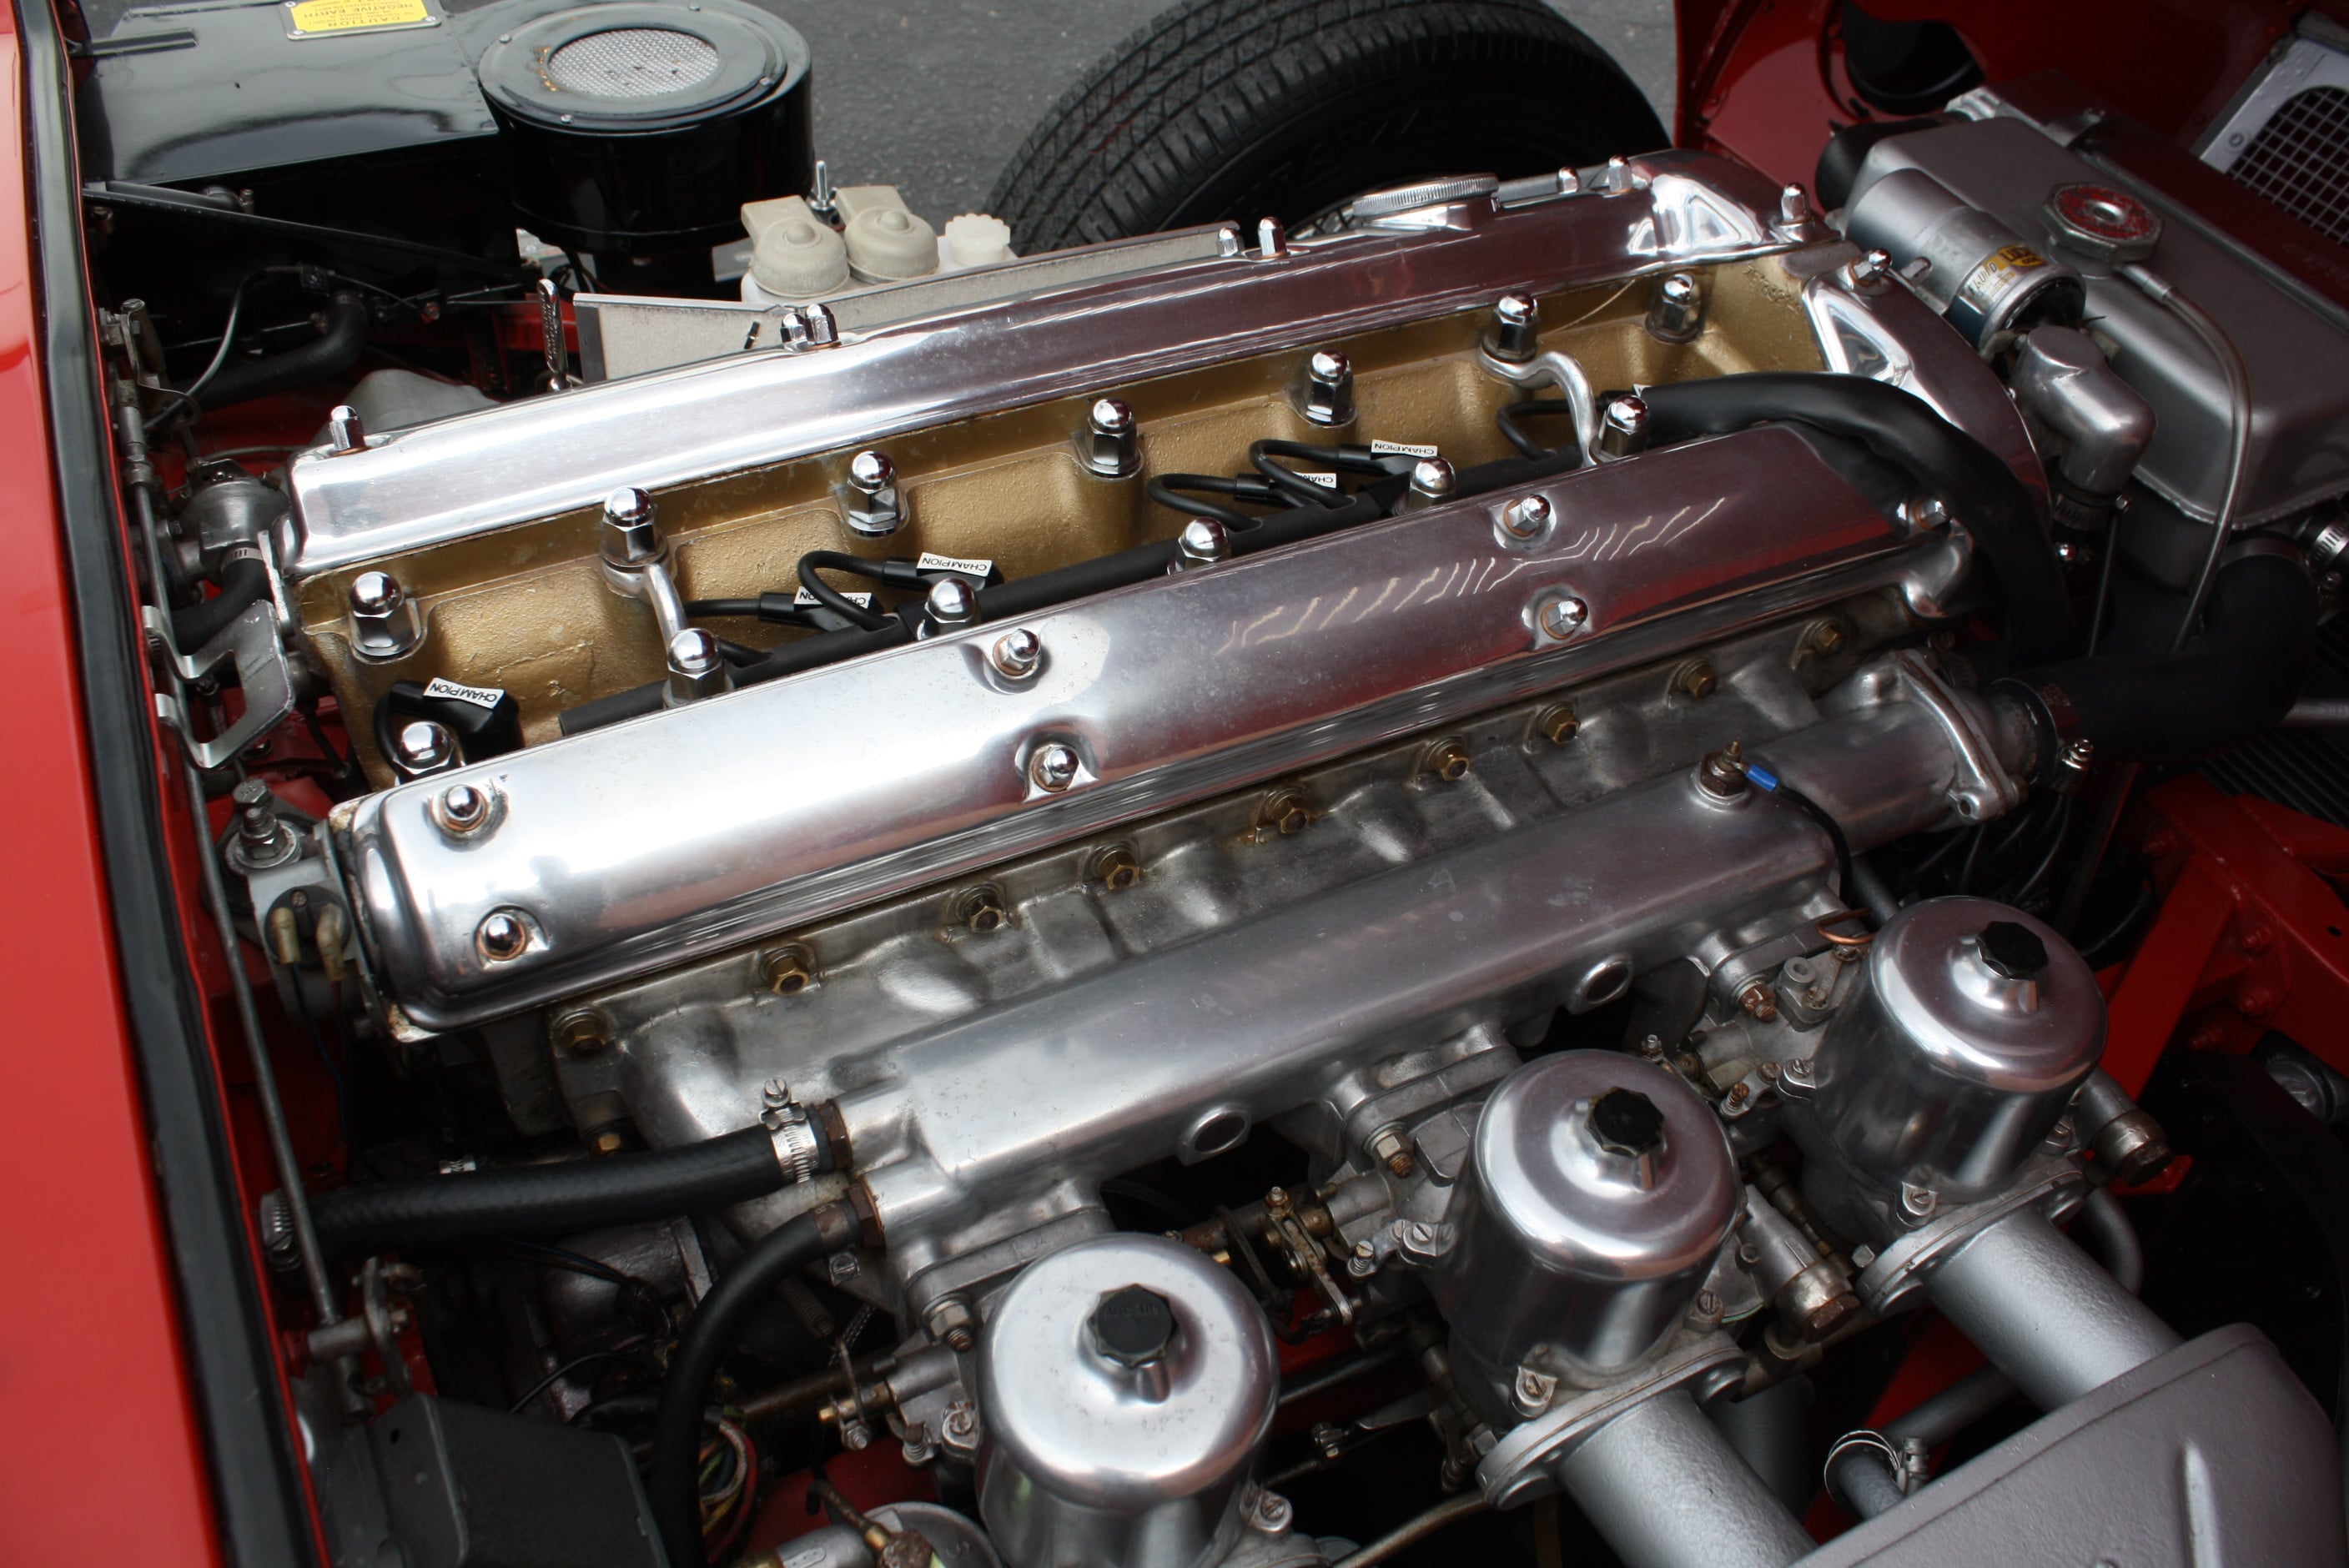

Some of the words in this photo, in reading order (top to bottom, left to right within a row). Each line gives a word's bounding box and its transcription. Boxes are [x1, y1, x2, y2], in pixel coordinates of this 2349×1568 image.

[304, 8, 346, 18] EARTH
[353, 3, 413, 13] NEGATIVE
[328, 17, 400, 28] CAUTION
[1374, 443, 1435, 455] CHAMPION
[922, 557, 988, 571] CHAMPION
[430, 683, 498, 702] CHAMPION
